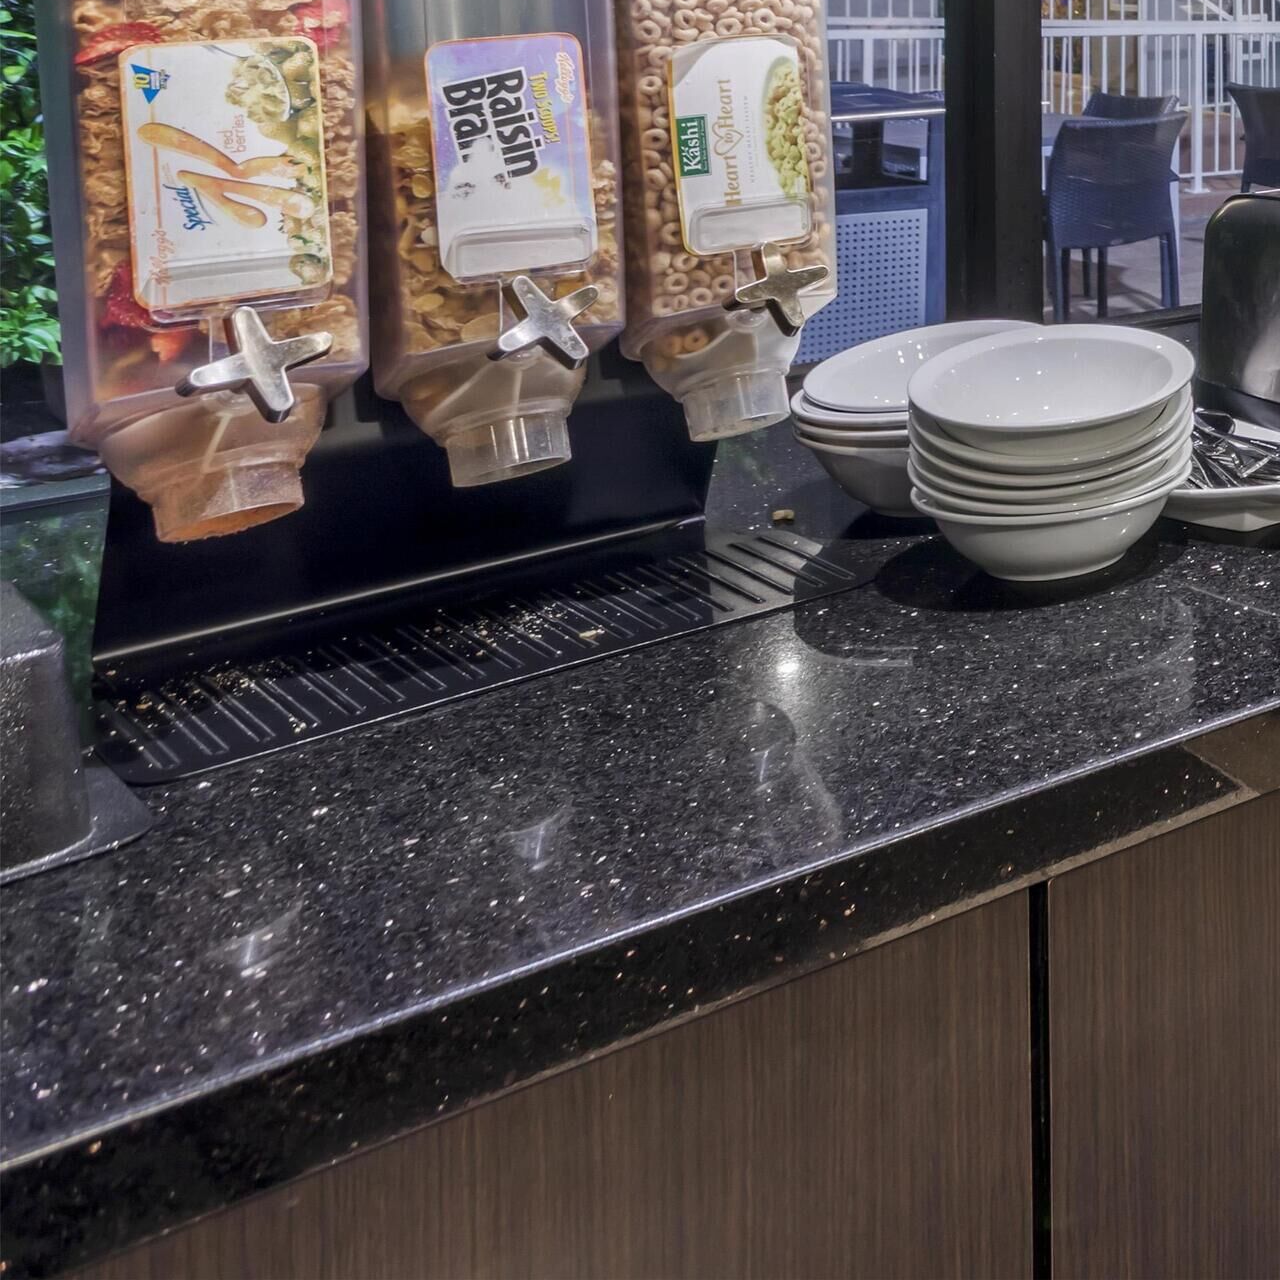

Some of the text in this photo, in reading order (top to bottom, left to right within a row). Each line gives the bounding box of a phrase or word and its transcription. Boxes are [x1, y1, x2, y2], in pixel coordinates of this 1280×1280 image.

[216, 130, 234, 150] red
[231, 113, 247, 153] berries
[485, 68, 543, 179] Raisin
[680, 120, 702, 172] Kashi
[717, 78, 742, 205] Heart to Heart
[162, 183, 213, 231] Special
